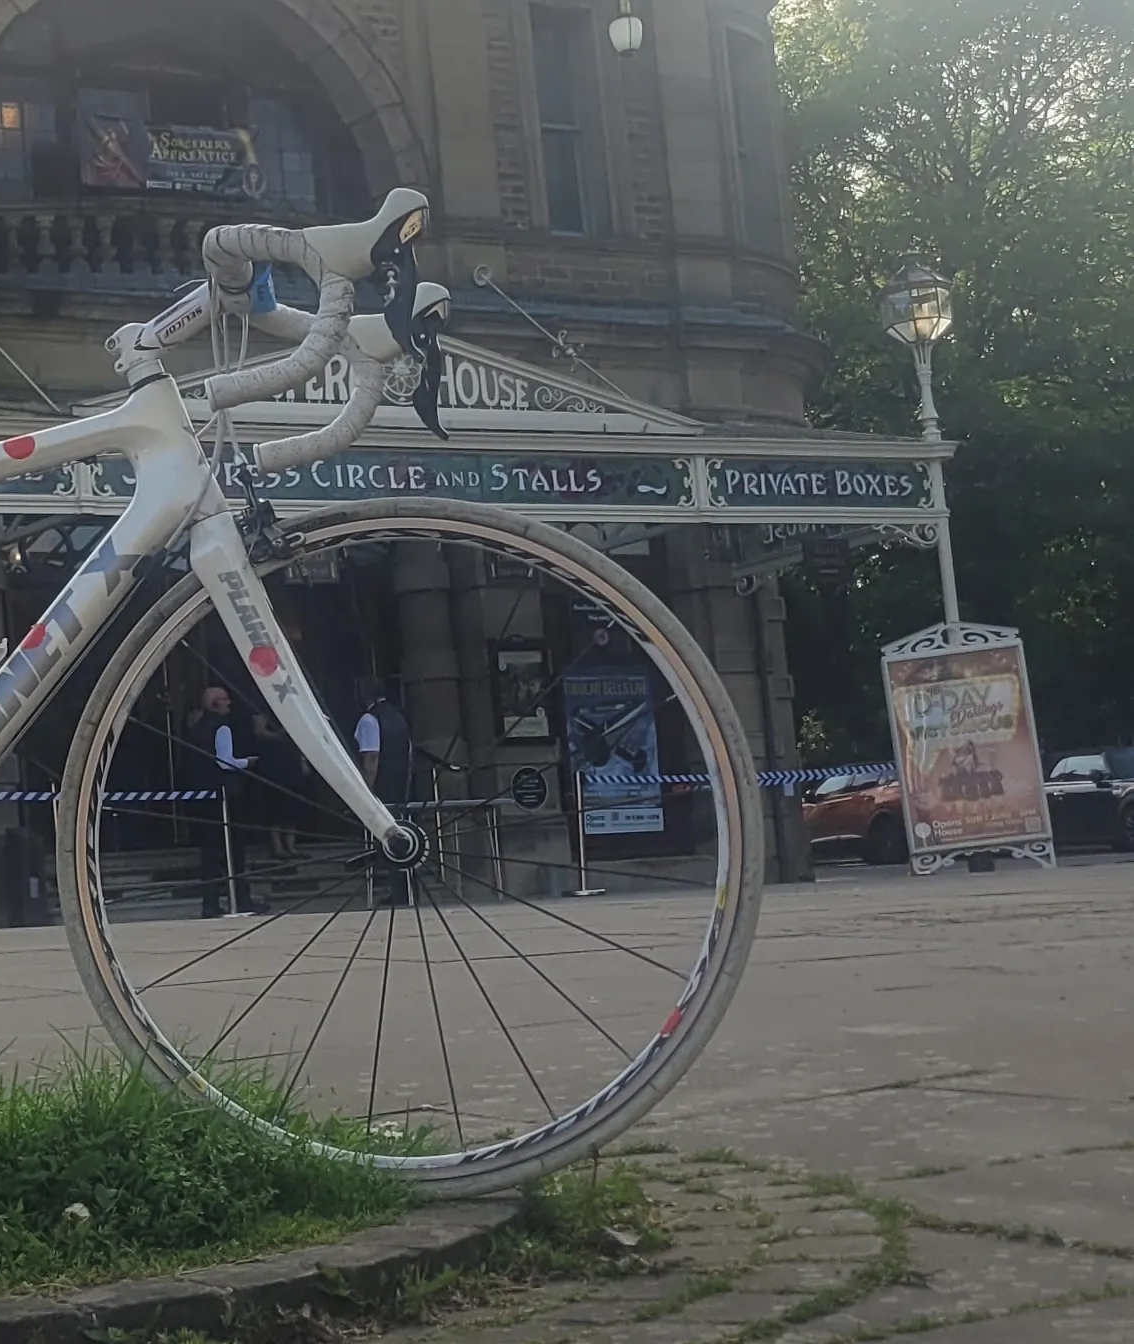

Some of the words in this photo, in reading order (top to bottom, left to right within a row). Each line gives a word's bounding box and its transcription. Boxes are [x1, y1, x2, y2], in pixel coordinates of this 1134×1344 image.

[438, 353, 530, 408] HOUSE
[310, 459, 427, 490] CIRCLE
[435, 470, 481, 488] AND
[490, 463, 602, 494] STALLS
[724, 469, 828, 497] PRIVATE
[835, 469, 914, 498] BOXES
[79, 535, 134, 597] X
[271, 674, 299, 704] X
[932, 819, 963, 829] Opera
[933, 828, 963, 837] House
